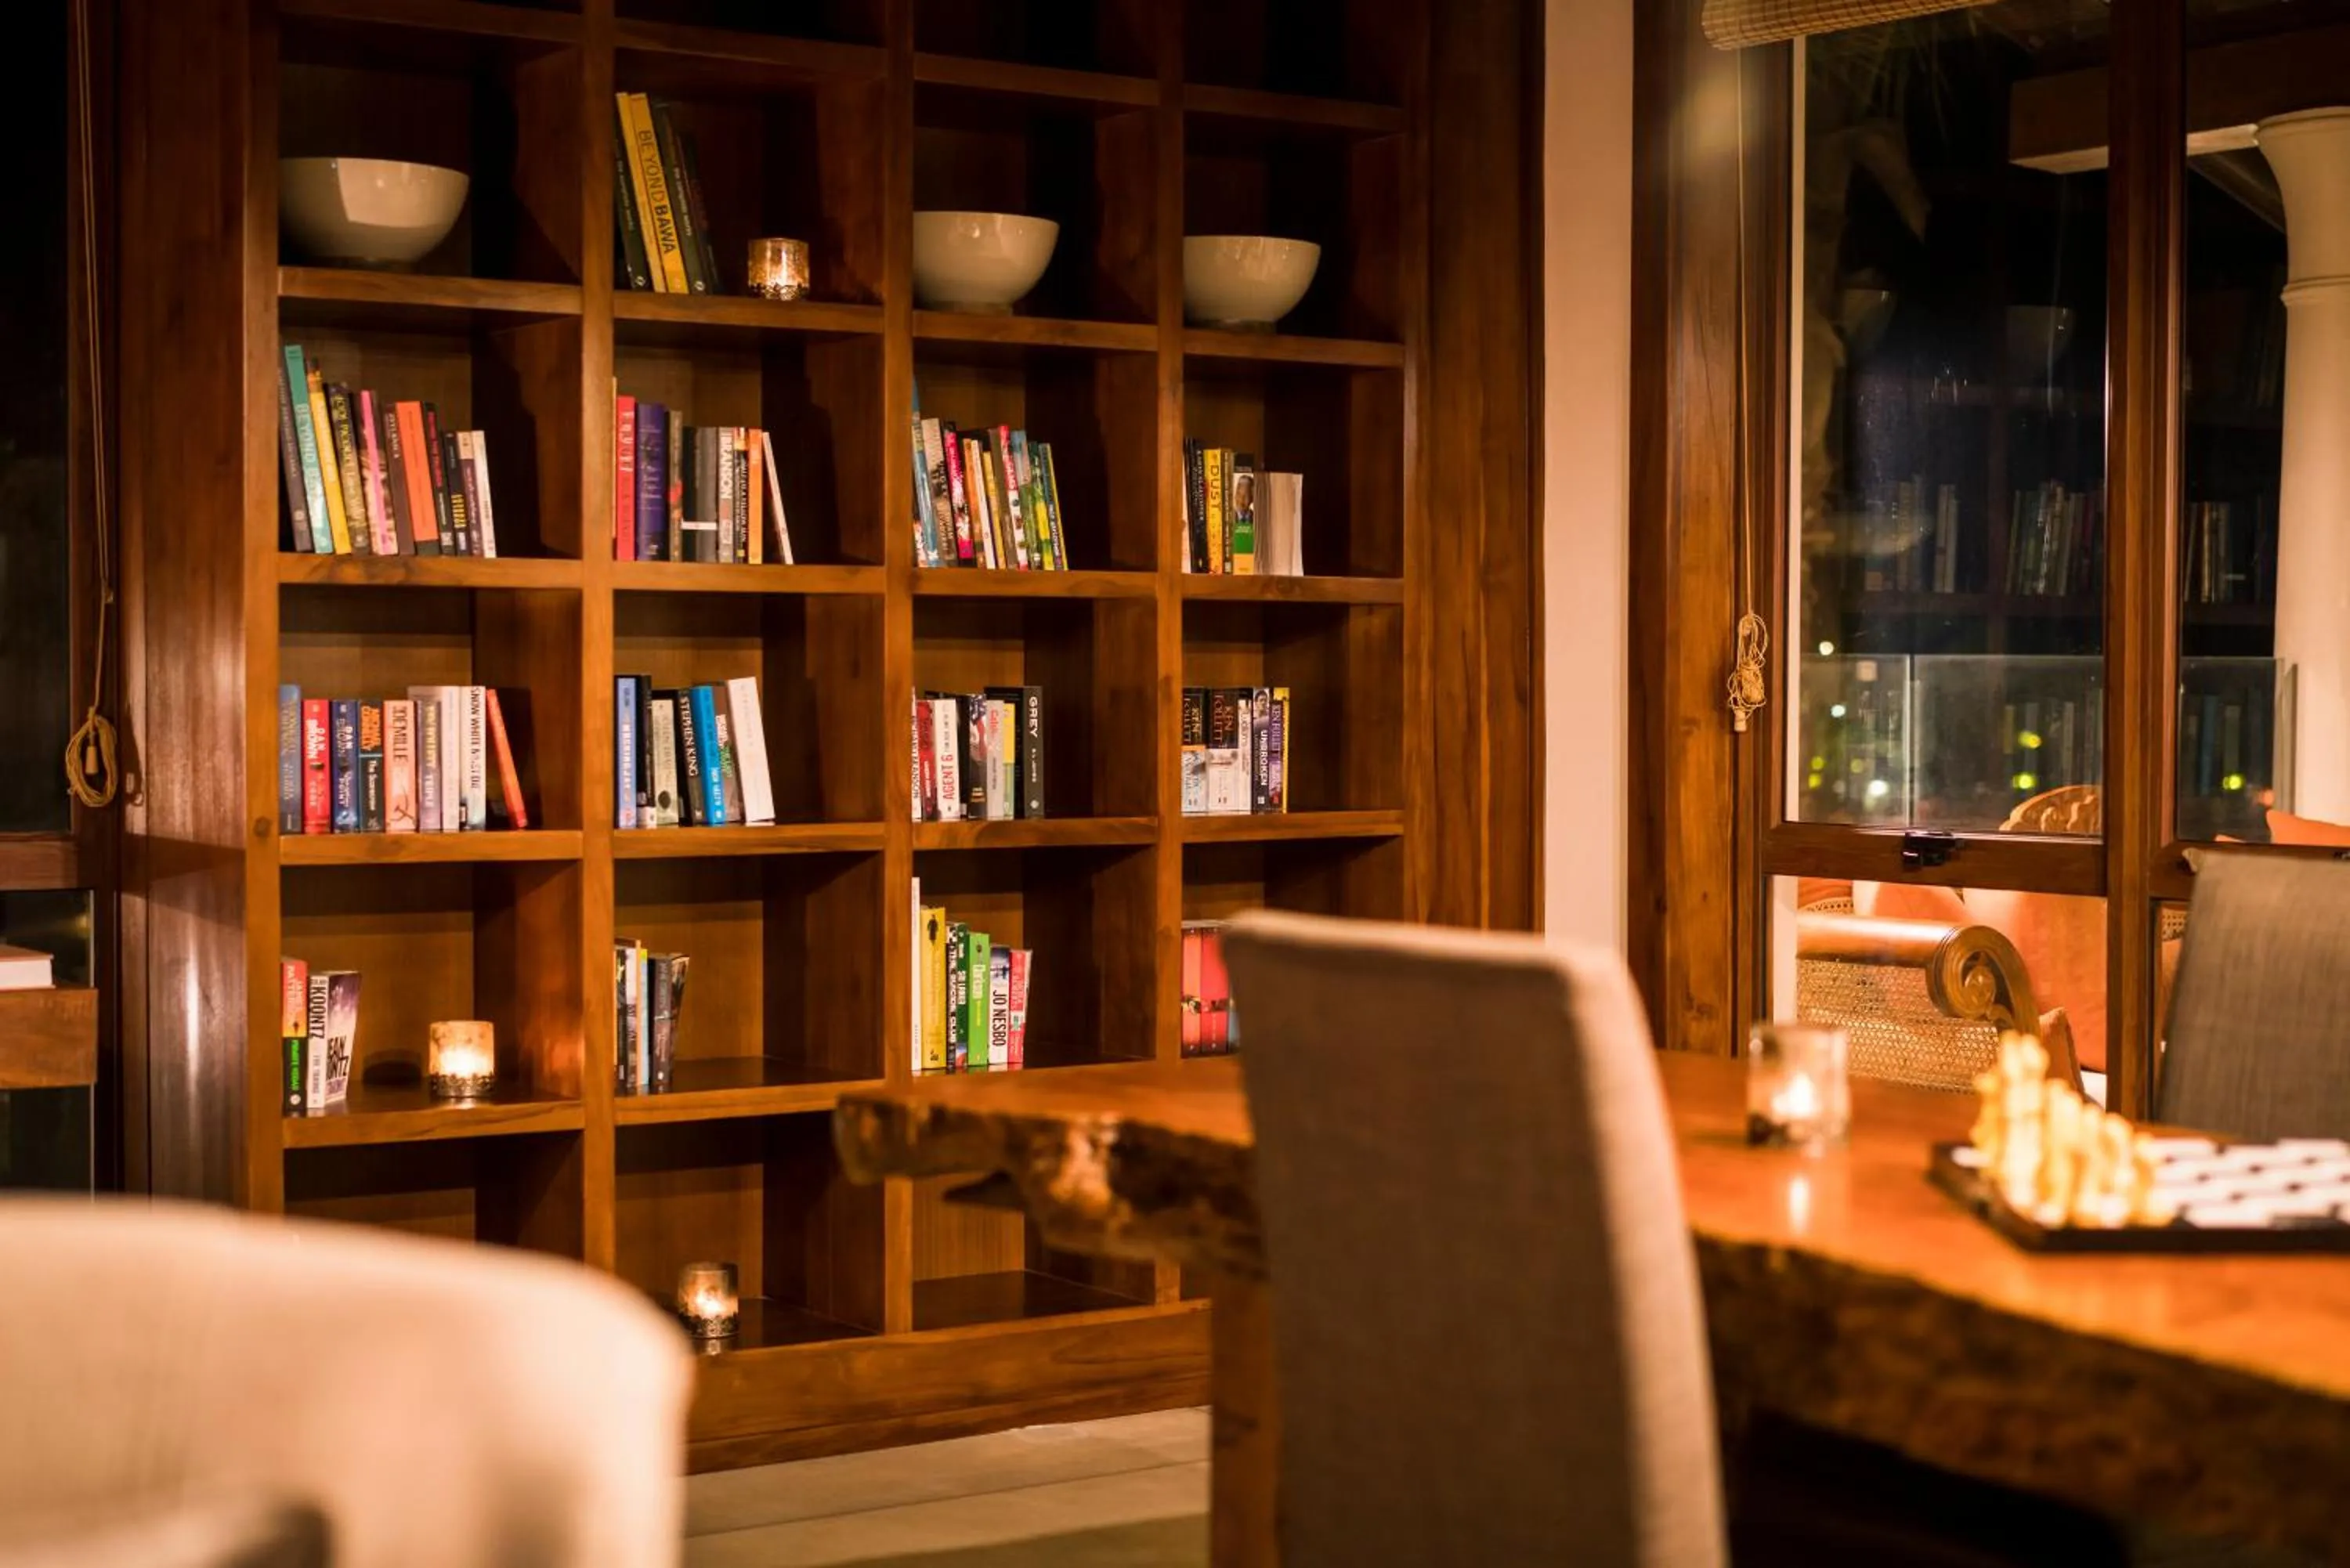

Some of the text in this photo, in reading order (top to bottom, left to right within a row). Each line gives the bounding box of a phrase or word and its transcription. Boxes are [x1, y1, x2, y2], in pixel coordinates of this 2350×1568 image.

[638, 130, 677, 255] BEYOND BAWA
[720, 436, 733, 500] BRANSON
[1210, 464, 1220, 509] DUST
[470, 688, 481, 716] SNOW
[1029, 696, 1038, 738] GREY
[306, 718, 317, 759] BROWN
[317, 727, 326, 751] DAN
[470, 717, 481, 747] WHITE
[680, 696, 699, 777] STEPHEN KING
[1272, 704, 1281, 759] KEN FOLLETT
[941, 764, 956, 800] AGENT
[309, 986, 326, 1039] KOONTZ
[993, 990, 1007, 1005] JO
